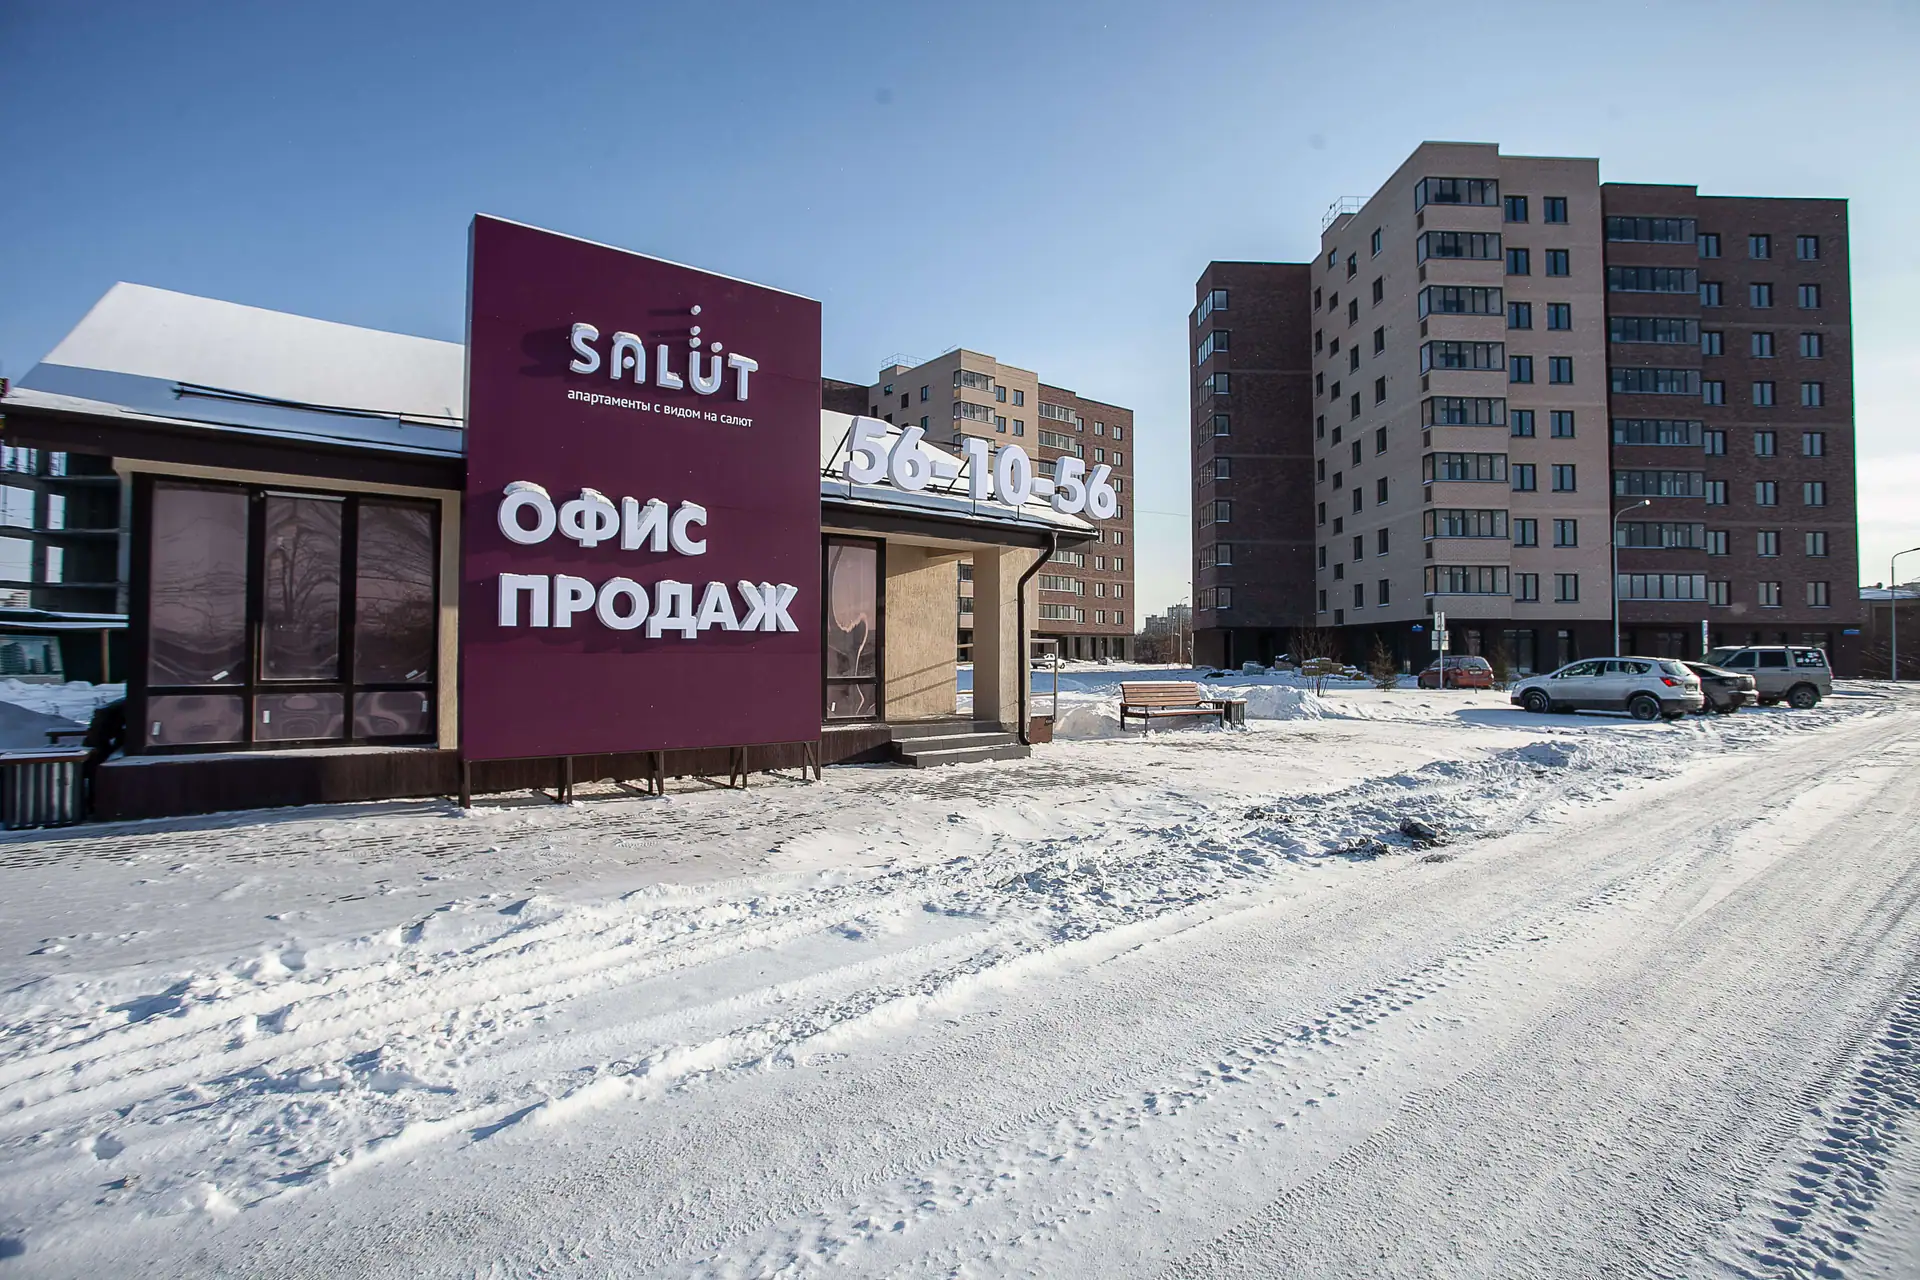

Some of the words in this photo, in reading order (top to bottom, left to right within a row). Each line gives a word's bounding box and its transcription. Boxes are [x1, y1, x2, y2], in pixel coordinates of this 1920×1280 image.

[567, 389, 651, 412] апартаменты
[653, 402, 661, 413] с
[663, 404, 701, 419] видом
[703, 410, 718, 422] на
[720, 413, 753, 427] салют
[843, 415, 1117, 520] 56-10-56
[497, 480, 707, 556] ОФИС
[498, 572, 799, 639] ПРОДАЖ
